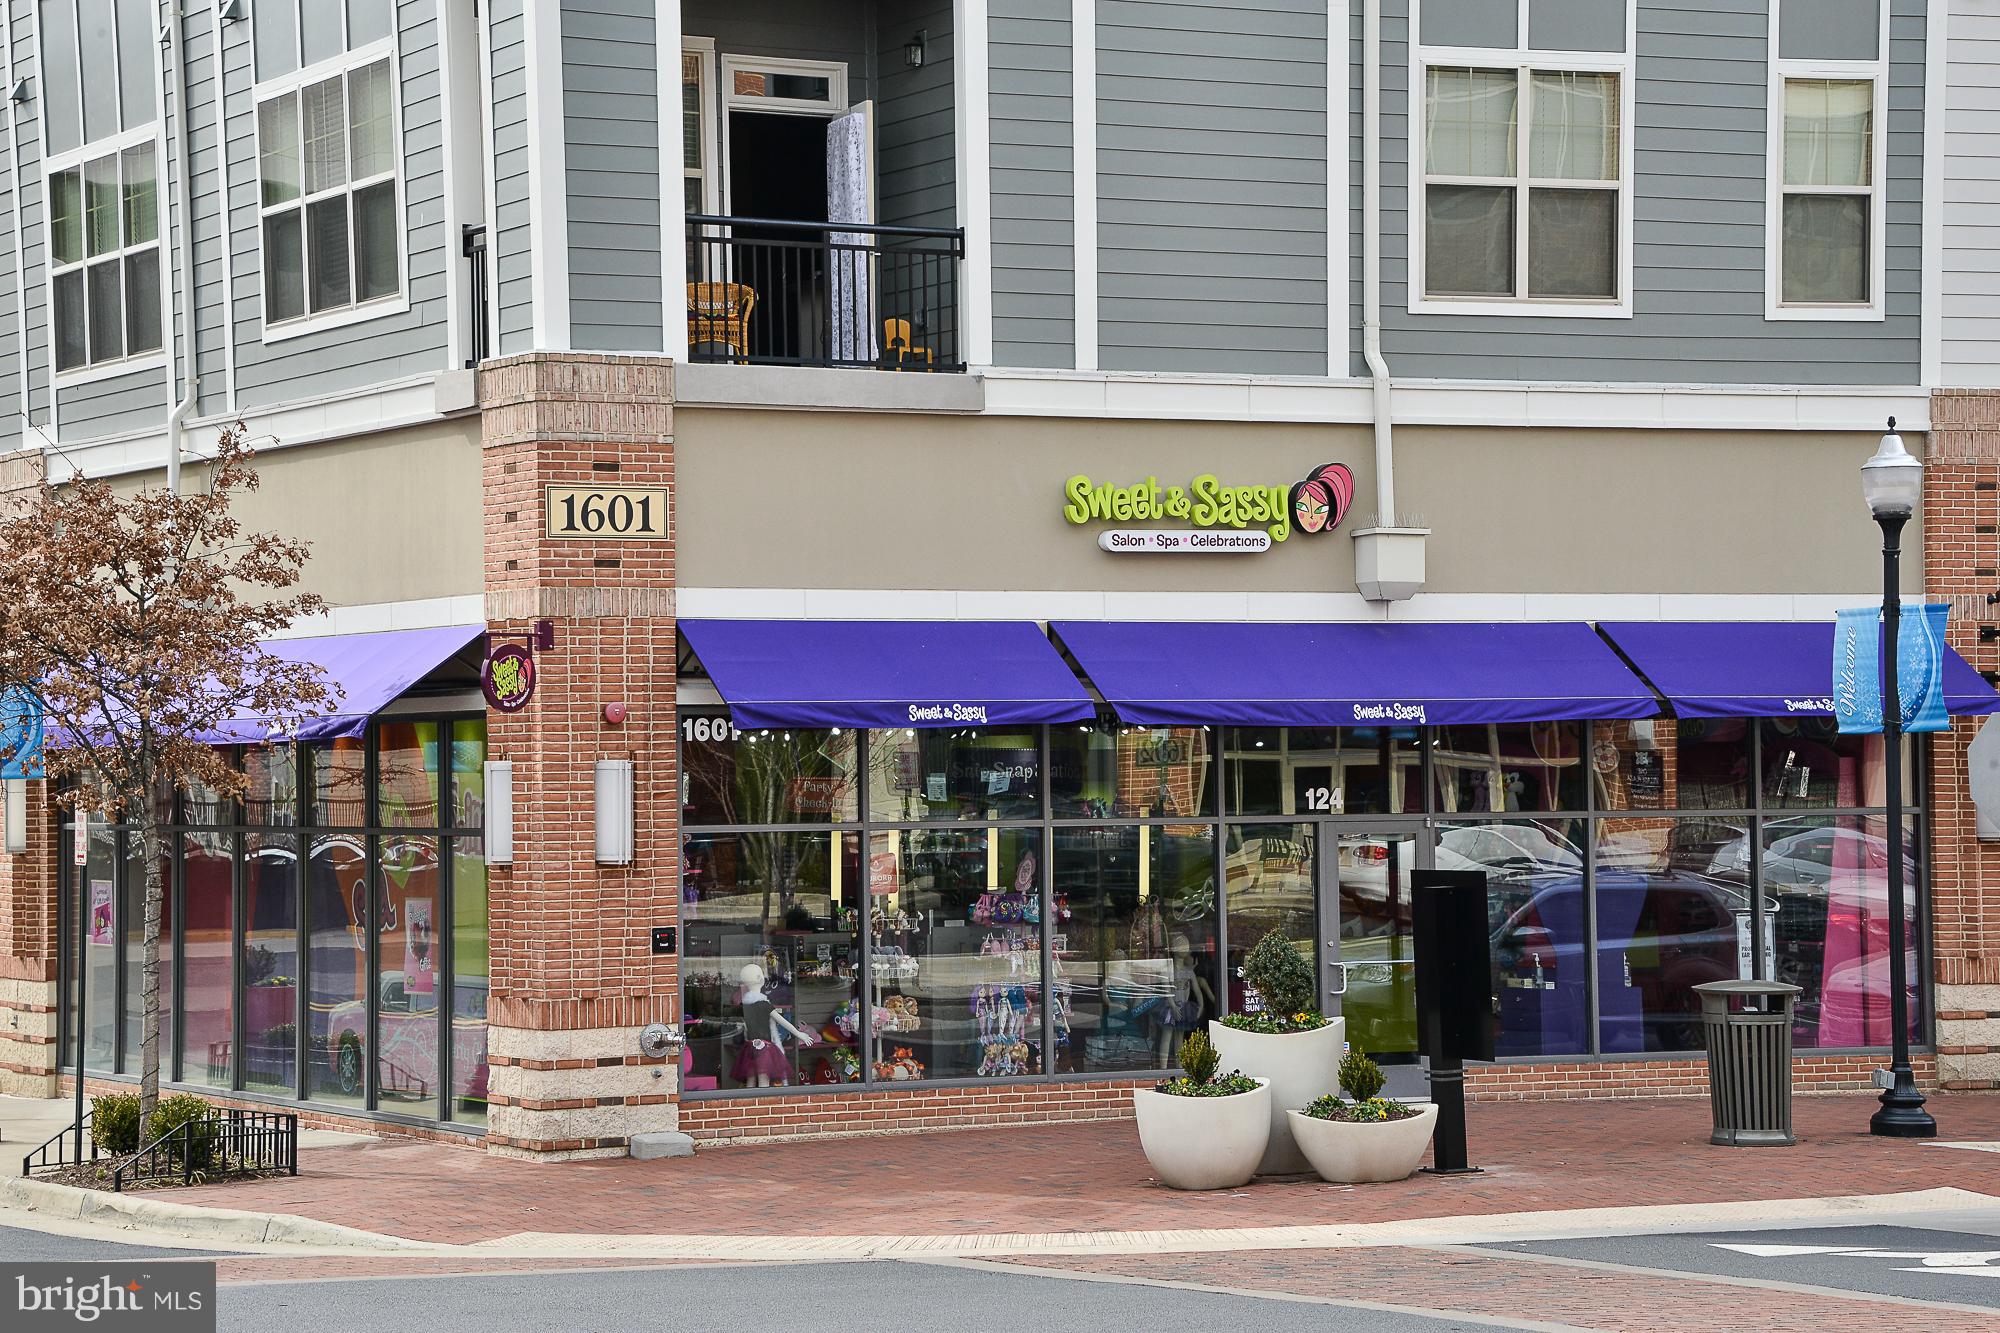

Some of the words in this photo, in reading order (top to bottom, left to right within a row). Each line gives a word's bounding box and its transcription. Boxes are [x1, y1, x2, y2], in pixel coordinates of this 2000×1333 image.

[560, 493, 656, 533] 1601
[1064, 474, 1164, 524] Sweet
[1164, 486, 1191, 520] &
[1191, 474, 1291, 542] Sassy
[1111, 534, 1146, 547] Salon
[1156, 534, 1180, 549] Spa
[1190, 534, 1266, 548] Celebrations
[492, 655, 514, 682] Sweet
[1840, 626, 1857, 717] Welcome
[496, 671, 518, 700] Sassy
[908, 704, 943, 721] Sweet
[943, 706, 953, 719] &
[952, 703, 988, 723] Sassy
[1353, 703, 1385, 721] Sweet
[1385, 706, 1394, 718] &
[1393, 702, 1427, 724] Sassy
[1784, 699, 1817, 712] Sweet
[993, 761, 1034, 784] Snap
[804, 780, 834, 798] Party
[1305, 787, 1344, 810] 124
[1245, 997, 1260, 1005] SAT
[1245, 1004, 1260, 1012] SUN
